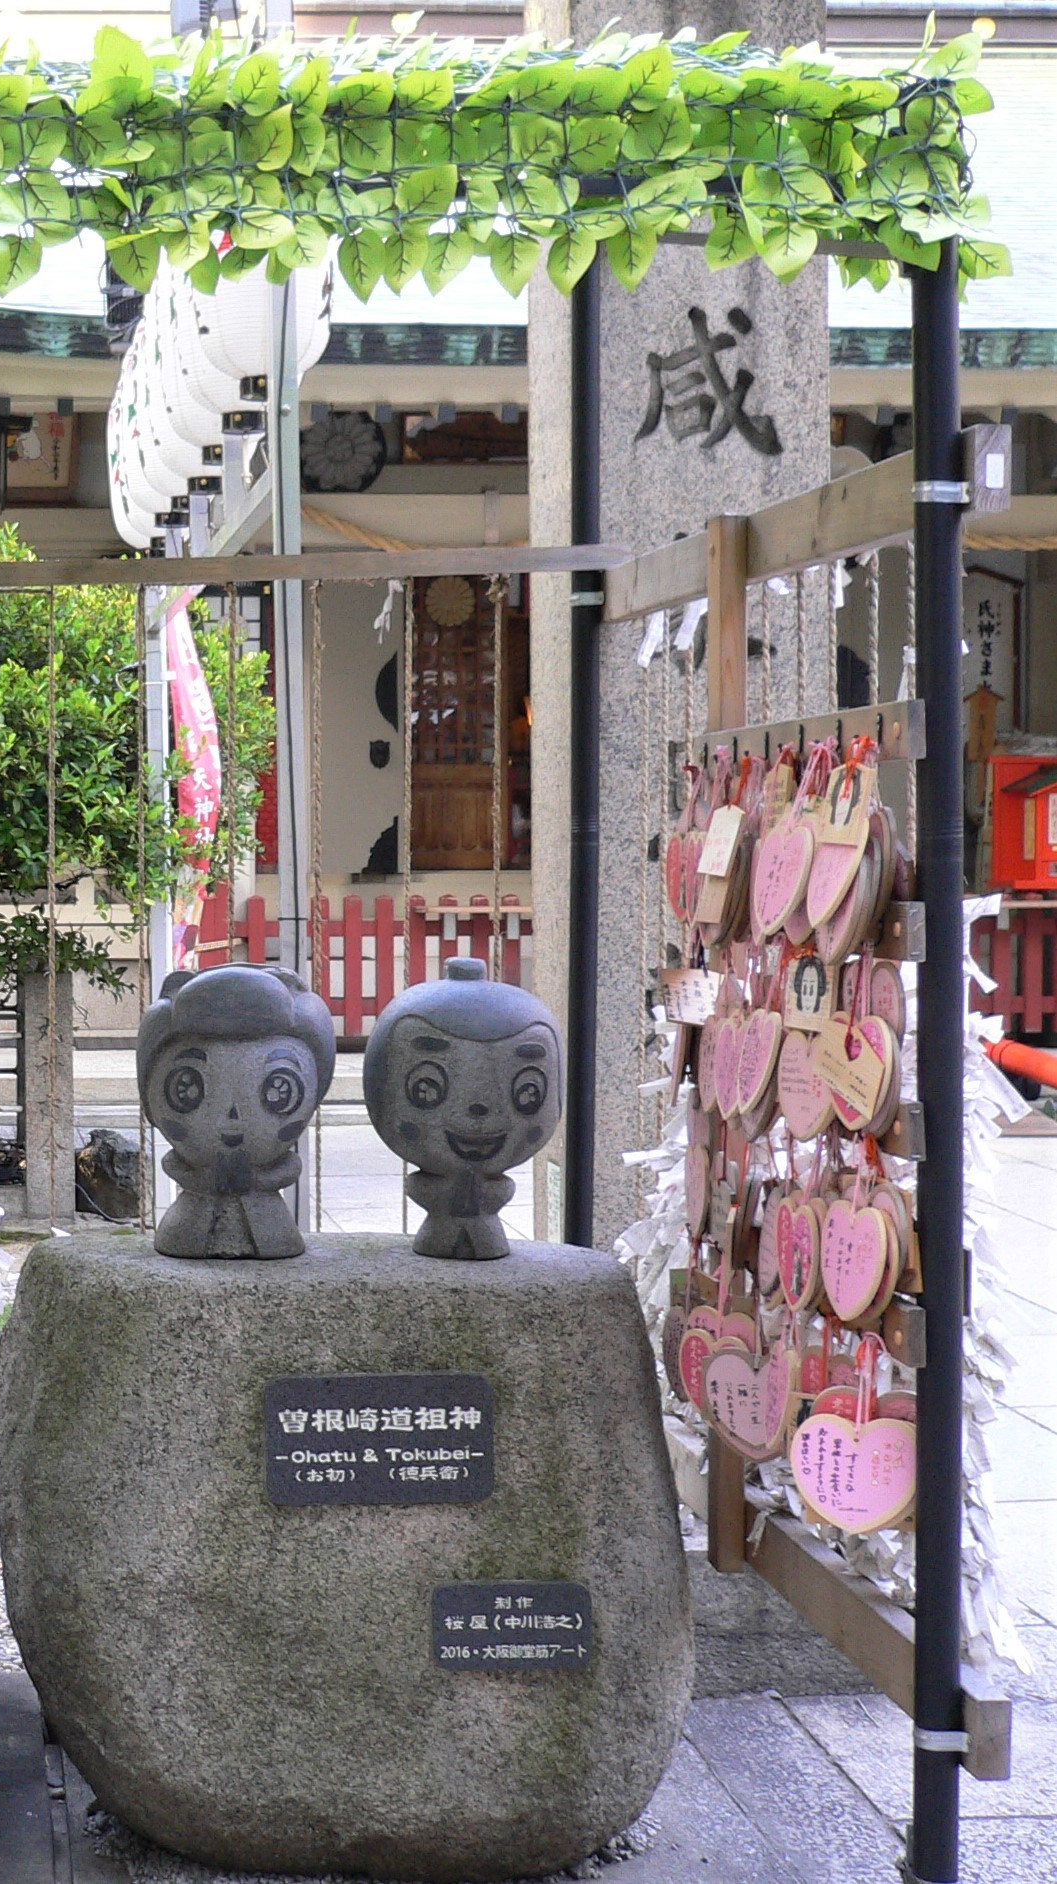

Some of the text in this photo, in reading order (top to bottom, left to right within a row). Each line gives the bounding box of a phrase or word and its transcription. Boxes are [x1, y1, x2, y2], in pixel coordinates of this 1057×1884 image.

[277, 1405, 482, 1434] 曽根崎道祖神
[362, 1448, 379, 1464] &
